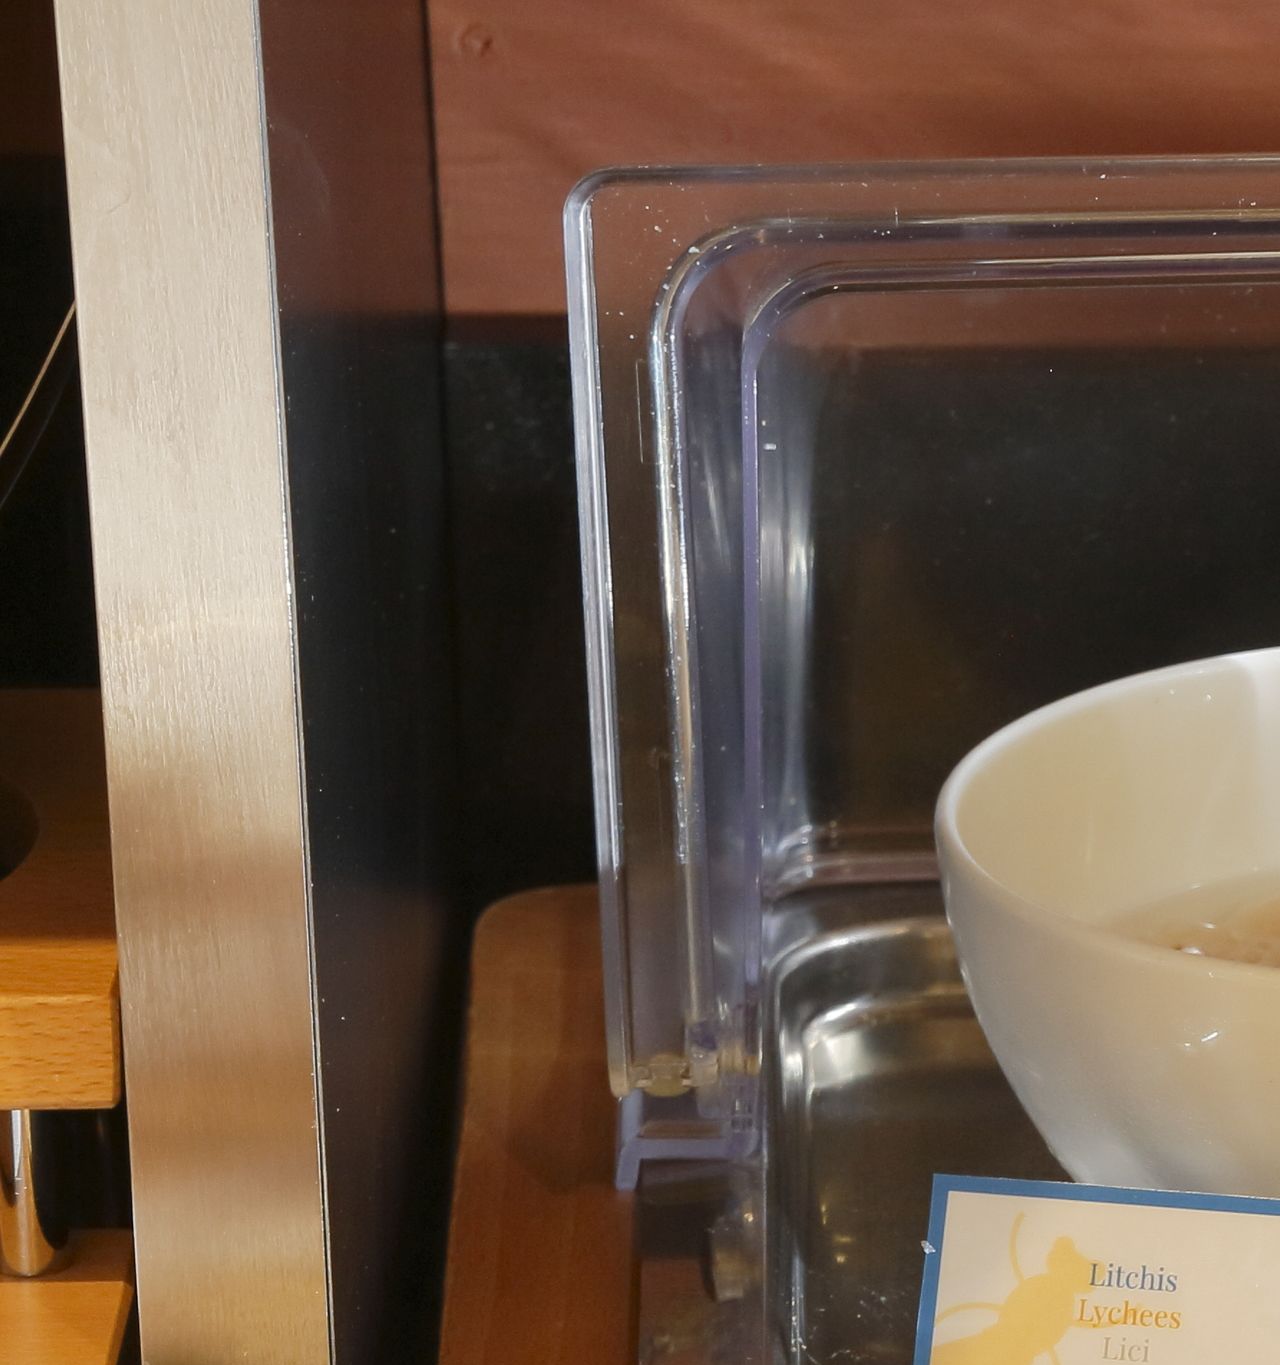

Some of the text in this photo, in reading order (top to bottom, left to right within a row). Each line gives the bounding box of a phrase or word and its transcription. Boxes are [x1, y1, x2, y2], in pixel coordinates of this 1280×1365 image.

[1089, 1263, 1178, 1292] Litchis
[1077, 1299, 1182, 1329] Lychees
[1102, 1337, 1149, 1363] Lici
